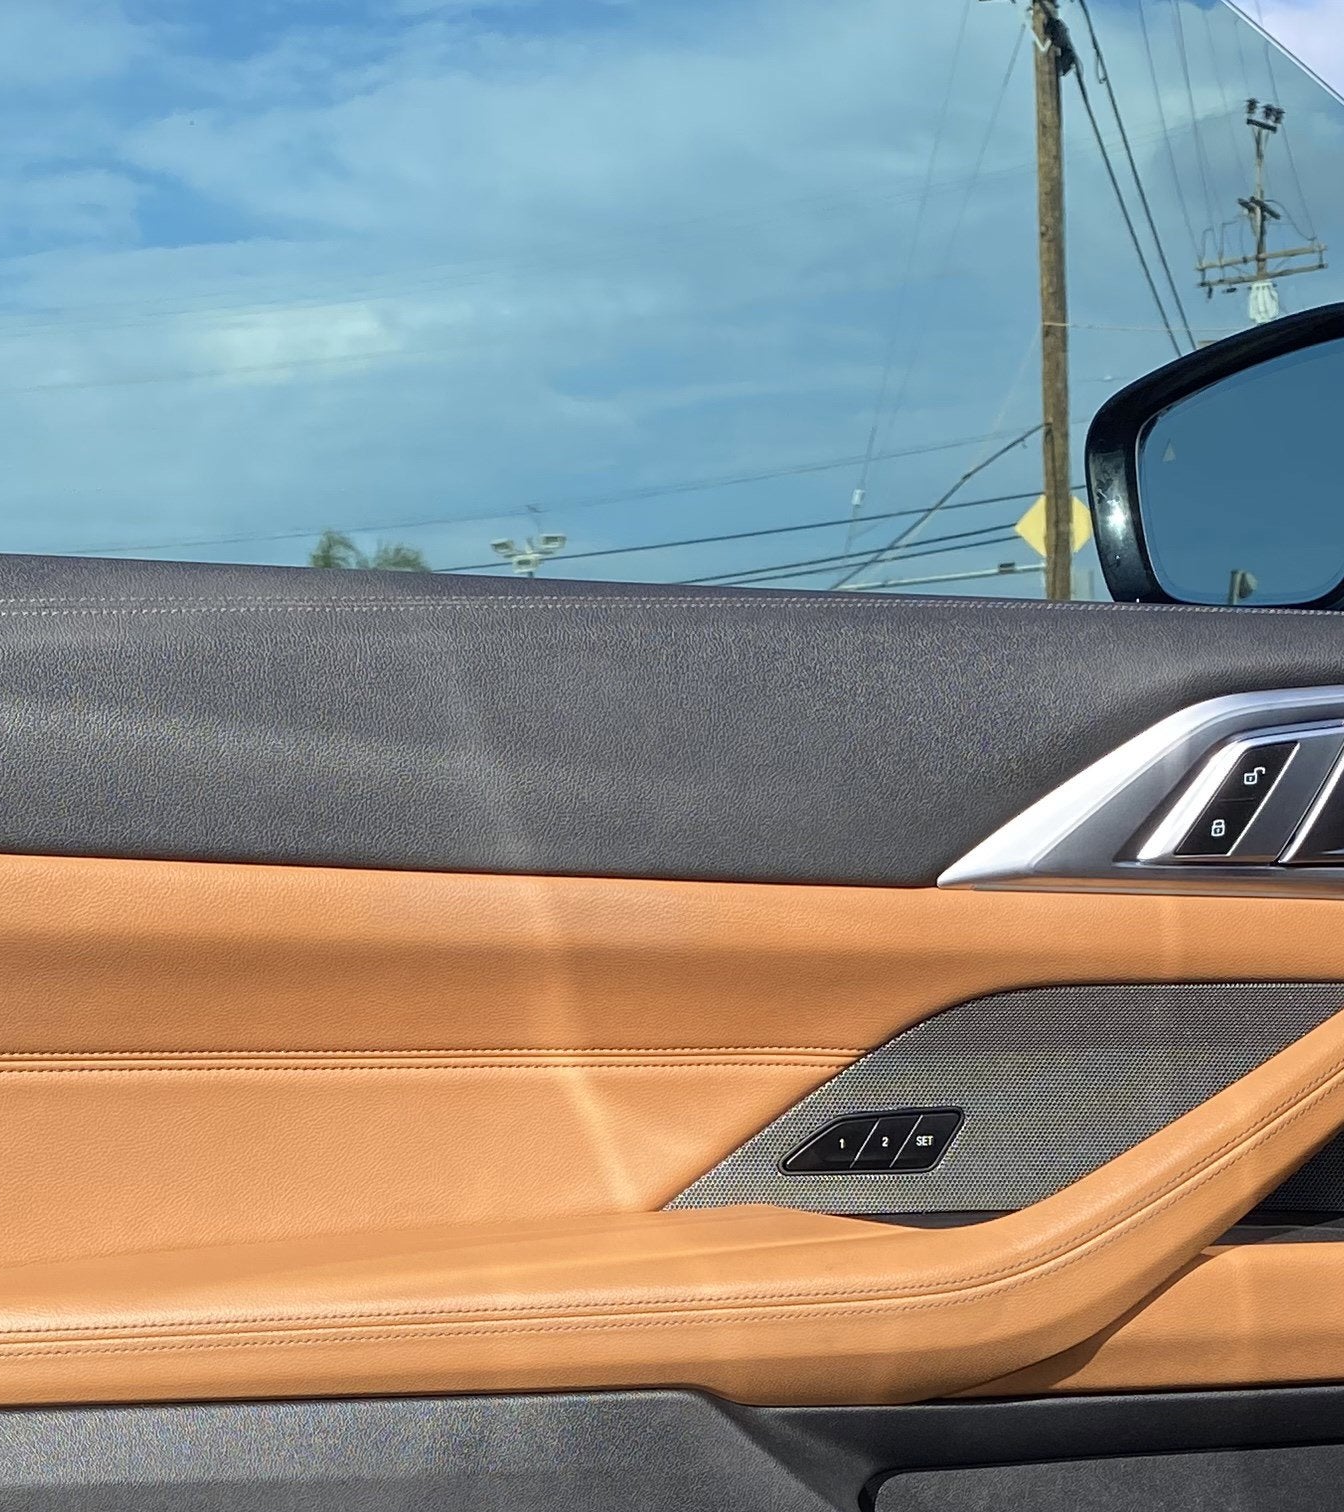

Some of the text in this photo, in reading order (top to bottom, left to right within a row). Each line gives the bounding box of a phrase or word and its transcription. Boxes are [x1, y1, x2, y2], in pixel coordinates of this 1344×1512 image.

[839, 1135, 934, 1149] 1 2 SET
